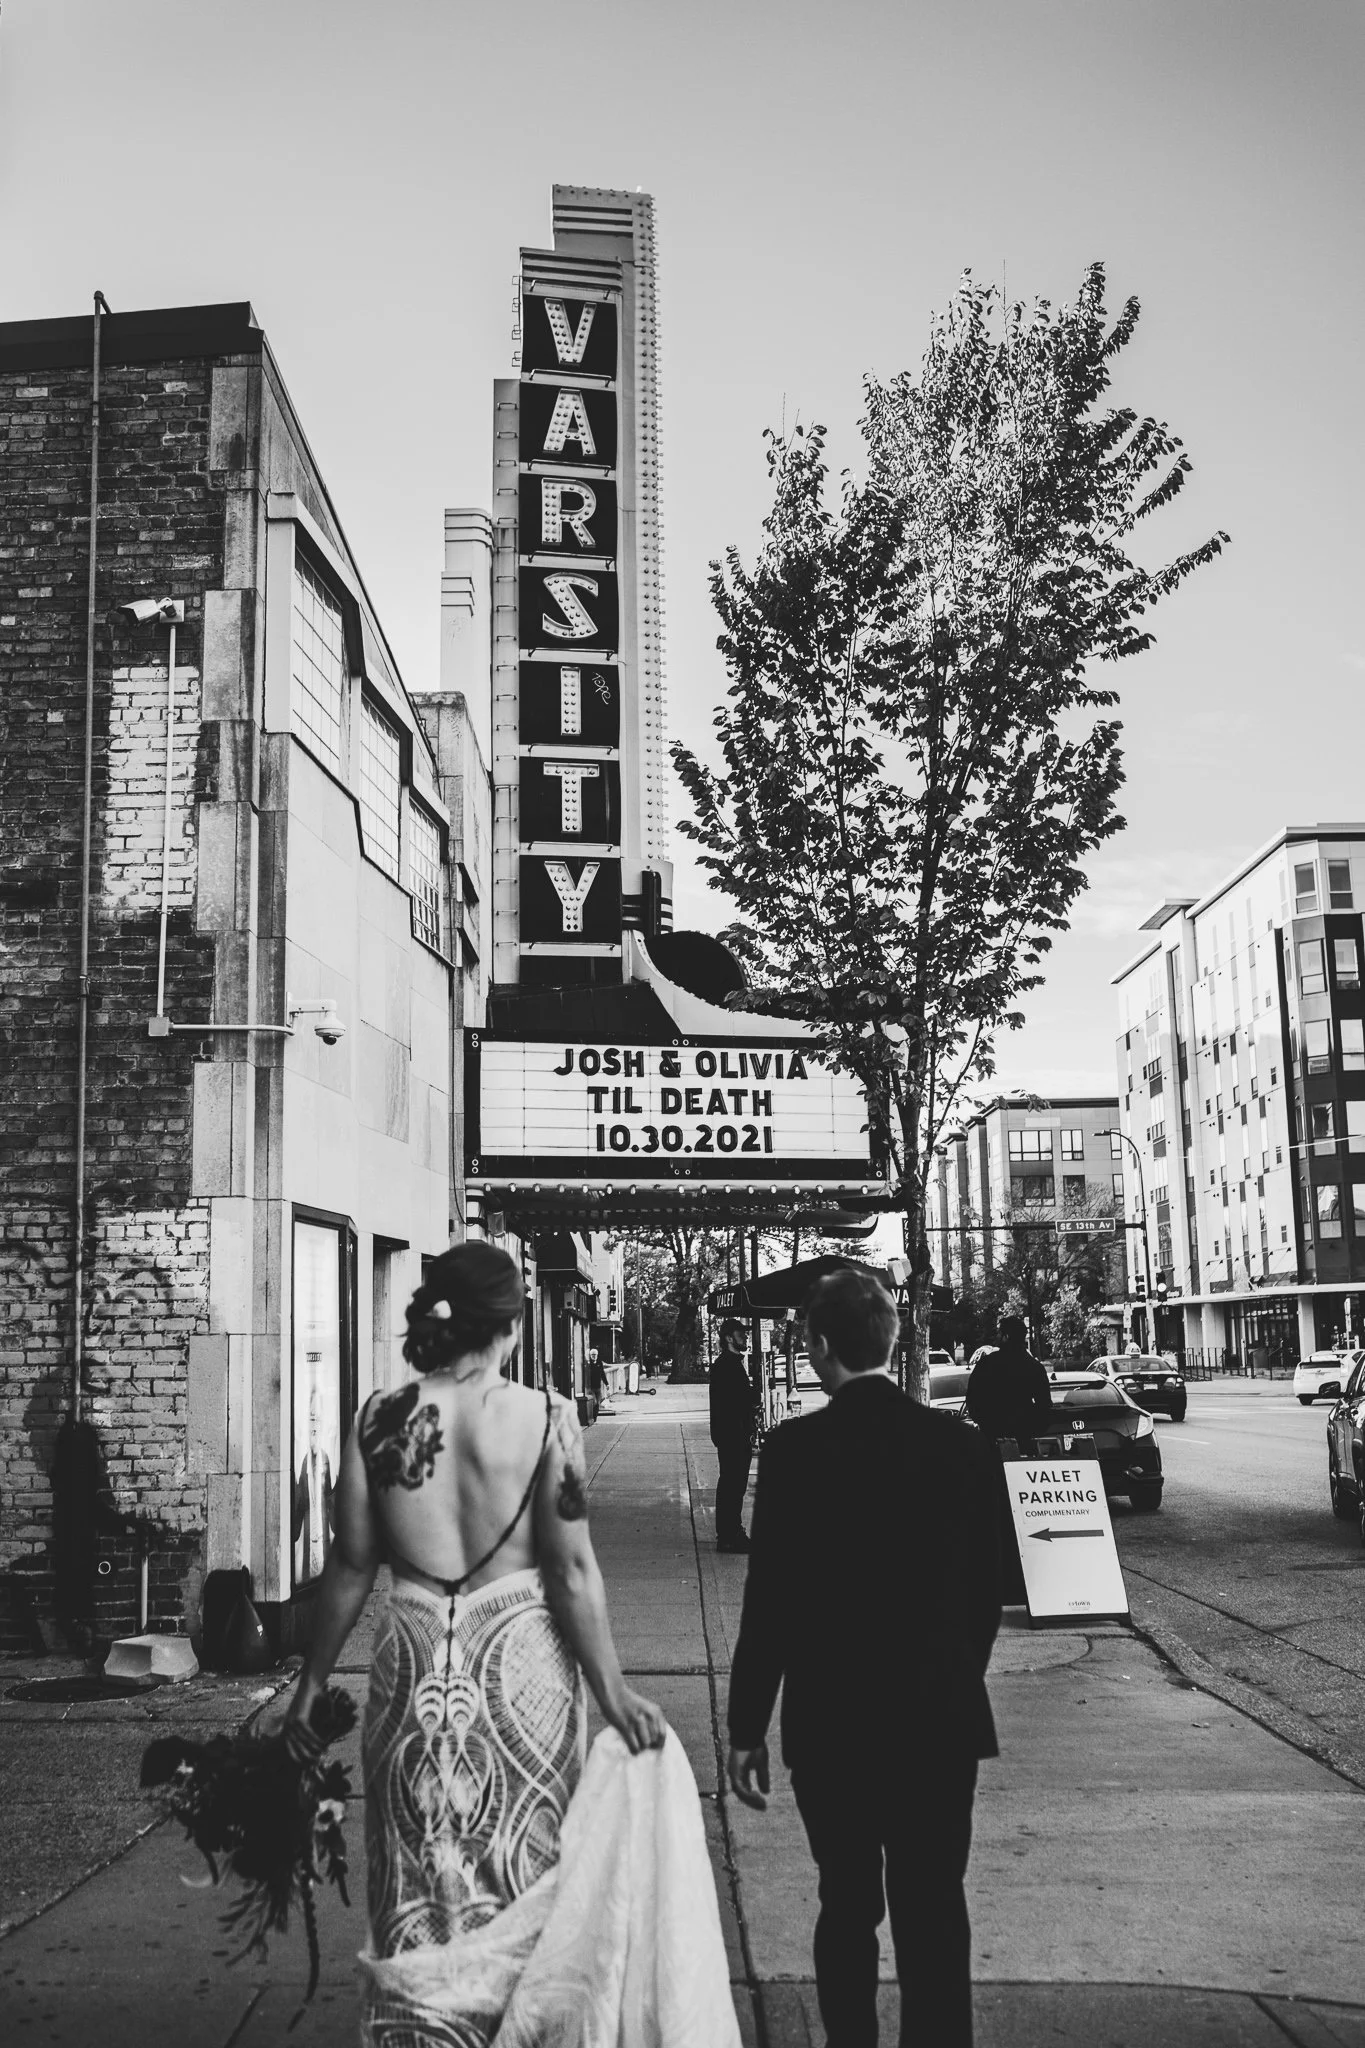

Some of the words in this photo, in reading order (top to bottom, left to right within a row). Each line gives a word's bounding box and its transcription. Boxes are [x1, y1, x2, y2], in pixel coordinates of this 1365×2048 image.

[541, 298, 600, 933] VARSITY
[554, 1047, 645, 1078] JOSH
[659, 1050, 682, 1078] &
[695, 1050, 808, 1080] OLIVIA
[587, 1086, 643, 1114] TIL
[660, 1087, 773, 1117] DEATH
[596, 1123, 773, 1154] 10.30.2021
[1059, 1222, 1072, 1231] SE
[1075, 1222, 1095, 1230] 13th
[1098, 1221, 1111, 1229] Av
[716, 1292, 735, 1309] VALET
[1026, 1470, 1081, 1484] VALET
[1018, 1489, 1097, 1505] PARKING
[1025, 1508, 1090, 1518] COMPLIMENTARY
